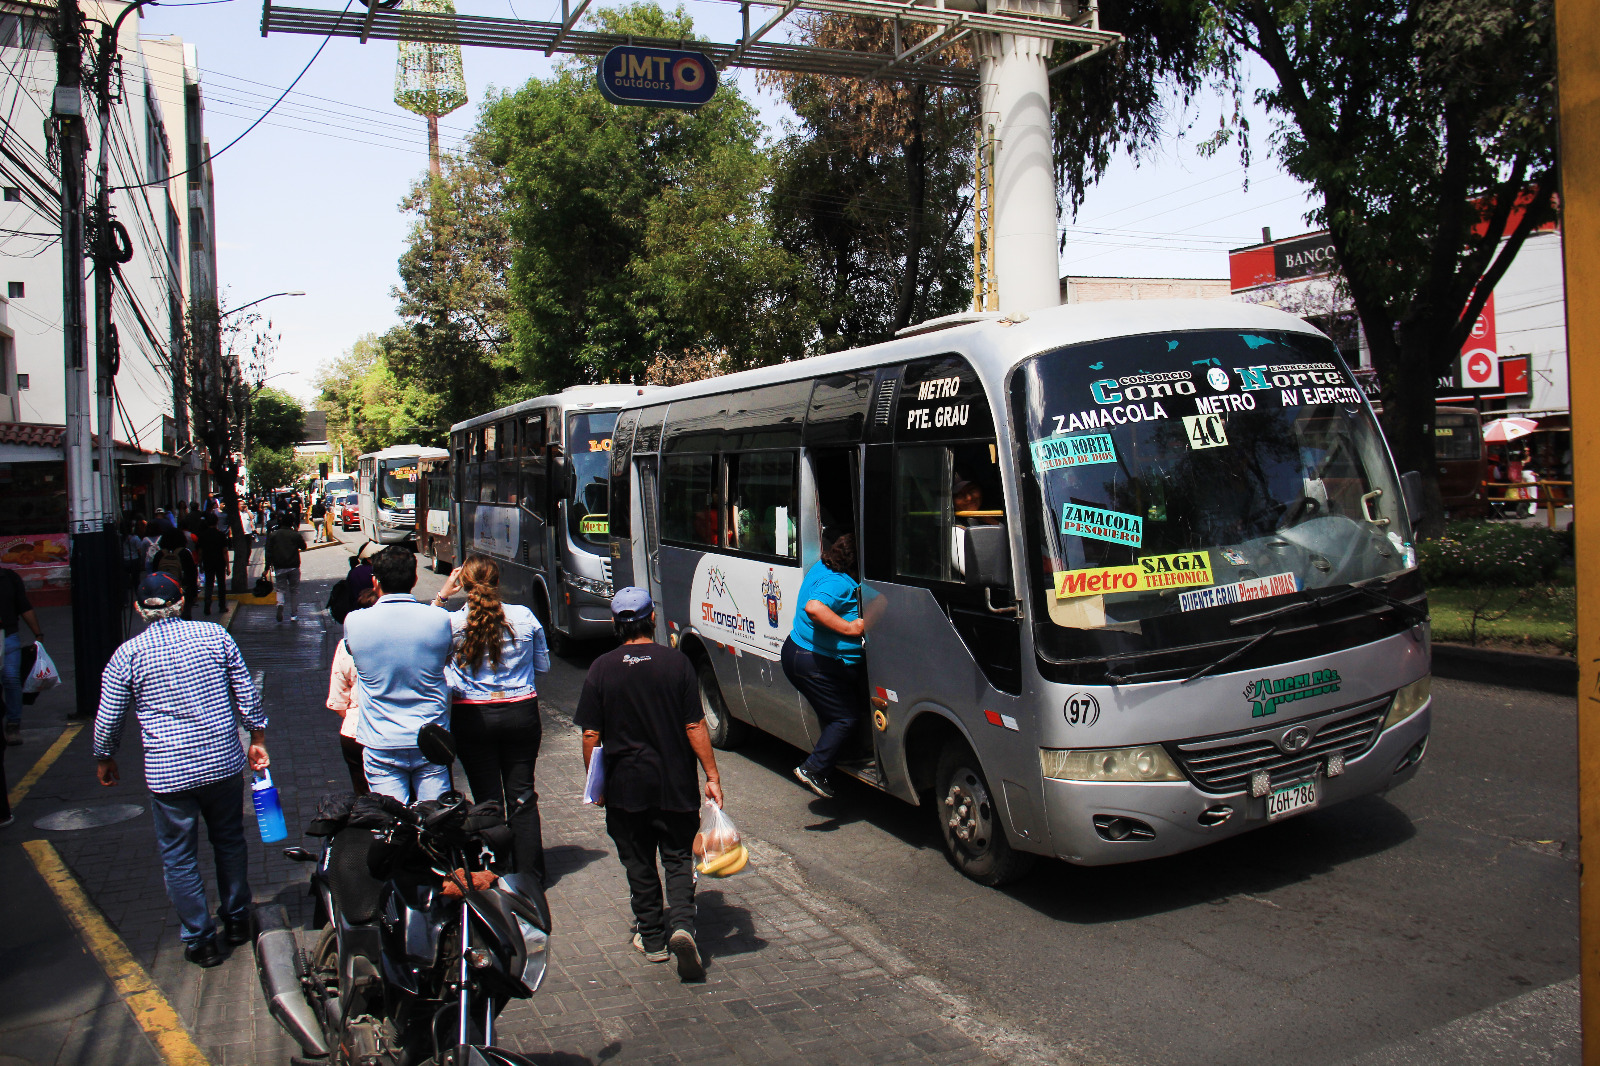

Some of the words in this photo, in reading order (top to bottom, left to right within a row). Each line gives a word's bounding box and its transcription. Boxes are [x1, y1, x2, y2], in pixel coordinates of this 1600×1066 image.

[615, 53, 671, 81] JMT
[614, 78, 671, 90] outdoors
[1285, 245, 1336, 268] BANCO
[1119, 371, 1192, 386] CONSORCIO
[1269, 363, 1336, 373] EMPRESARIAL
[918, 376, 960, 400] METRO
[1090, 378, 1197, 405] Cono
[1233, 365, 1342, 391] Norte
[907, 408, 932, 430] PTE.
[935, 405, 970, 428] GRAU
[1052, 402, 1169, 435] ZAMACOLA
[1195, 392, 1256, 415] METRO
[1281, 389, 1298, 407] AV
[1302, 387, 1361, 405] EJERCITO
[1193, 416, 1225, 446] 4C
[588, 438, 612, 452] LO
[1034, 440, 1069, 461] CONO
[1072, 436, 1111, 455] NORTE
[1040, 456, 1075, 470] CIUDAD
[1077, 454, 1090, 464] DE
[1092, 451, 1114, 463] DIOS
[582, 521, 609, 533] Metr
[1065, 506, 1140, 533] ZAMACOLA
[1064, 521, 1140, 543] PESQUERO
[1141, 554, 1207, 575] SAGA
[1060, 570, 1138, 594] Metro
[1144, 570, 1210, 588] TELEFONICA
[1181, 589, 1215, 612] PUENTE
[1215, 585, 1238, 606] GRAU
[1239, 582, 1259, 602] Plaza
[1260, 580, 1270, 598] de
[1269, 573, 1295, 597] ARMAS
[1242, 680, 1256, 699] LOS
[1251, 668, 1333, 718] ANGELES
[1070, 699, 1091, 725] 97
[1268, 783, 1315, 815] Z6H-786
